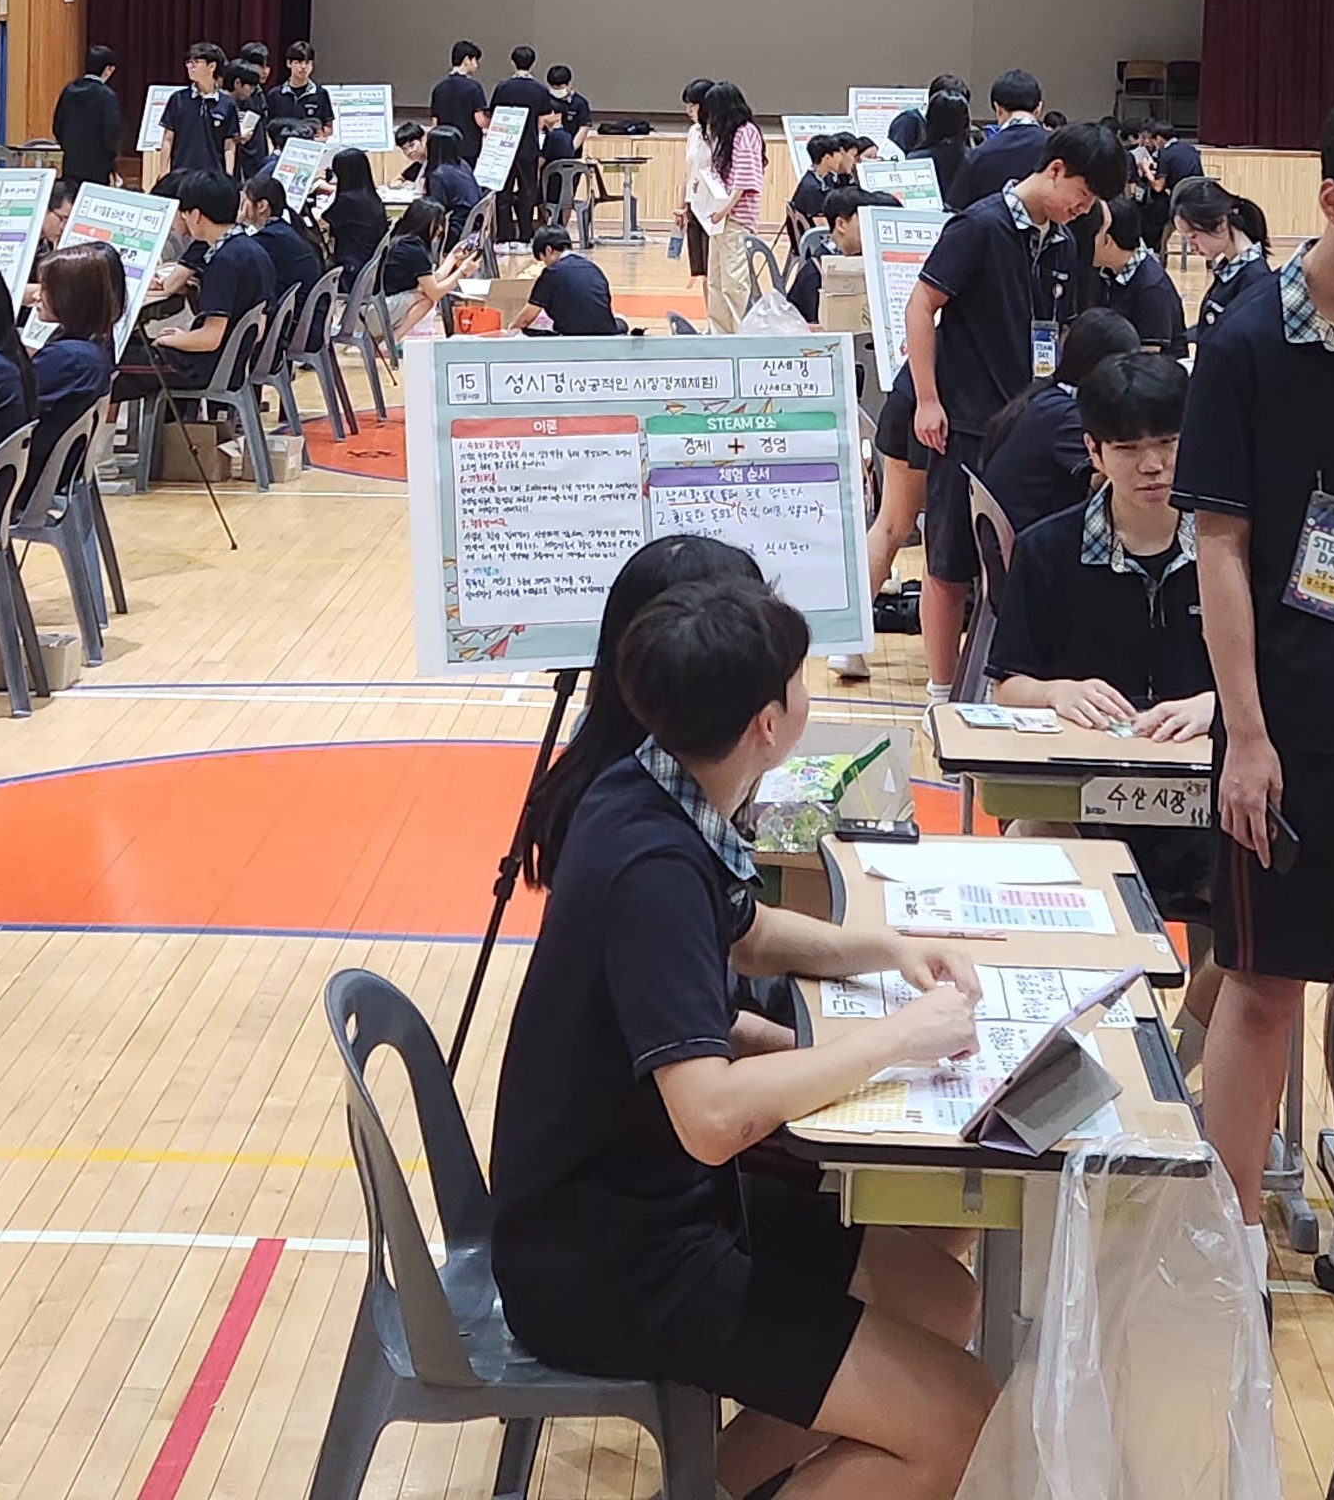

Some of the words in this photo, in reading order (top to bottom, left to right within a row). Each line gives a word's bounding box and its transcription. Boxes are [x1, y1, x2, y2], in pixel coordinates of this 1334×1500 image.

[882, 225, 893, 235] 21
[763, 360, 810, 378] 신세경
[456, 374, 475, 389] 15
[505, 373, 565, 394] 성시경
[570, 377, 629, 393] (성공적인
[633, 376, 718, 391] 시장경제체험)
[707, 417, 754, 431] STEAM
[755, 416, 777, 428] 요소
[681, 437, 711, 455] 경제
[759, 437, 787, 453] 경영
[719, 468, 743, 482] 체험
[746, 467, 770, 481] 순서
